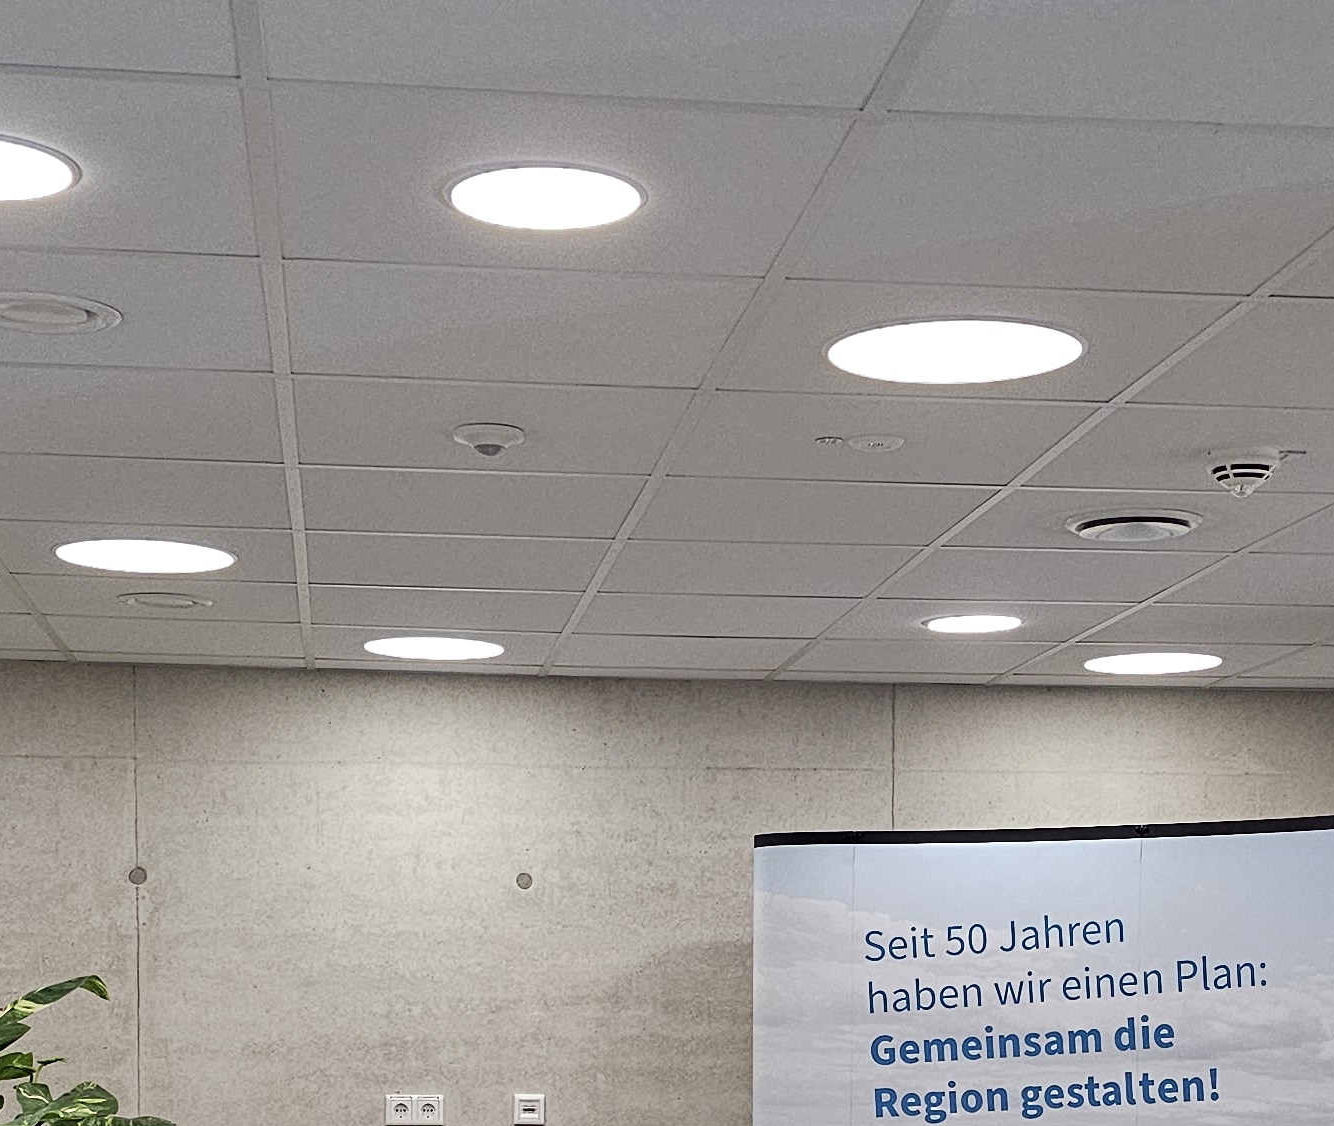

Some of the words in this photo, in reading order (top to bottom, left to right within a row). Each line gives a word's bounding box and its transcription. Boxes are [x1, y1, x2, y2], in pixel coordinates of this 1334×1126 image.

[864, 926, 935, 962] Seit
[945, 922, 988, 956] 50
[999, 914, 1125, 952] Jahren
[868, 977, 983, 1014] haben
[994, 971, 1053, 1006] wir
[1062, 966, 1163, 1002] einen
[1175, 955, 1268, 994] Plan:
[869, 1024, 1103, 1067] Gemeinsam
[1113, 1014, 1175, 1052] die
[873, 1080, 1009, 1124] Region
[1019, 1067, 1220, 1119] gestalten!
